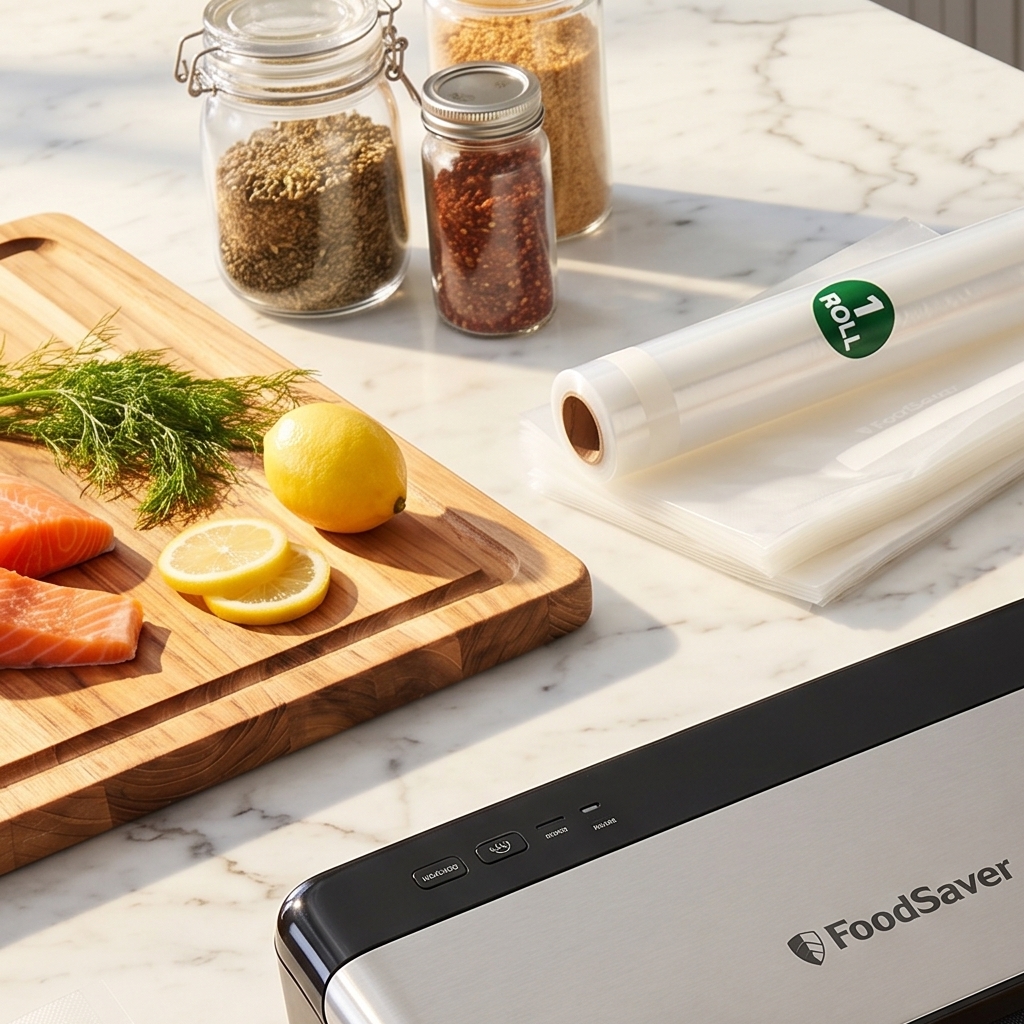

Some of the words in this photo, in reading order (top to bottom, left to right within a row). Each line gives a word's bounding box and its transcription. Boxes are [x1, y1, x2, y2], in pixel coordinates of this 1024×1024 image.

[818, 292, 861, 352] ROLL
[853, 294, 885, 318] 1
[823, 858, 1014, 951] FoodSaver
